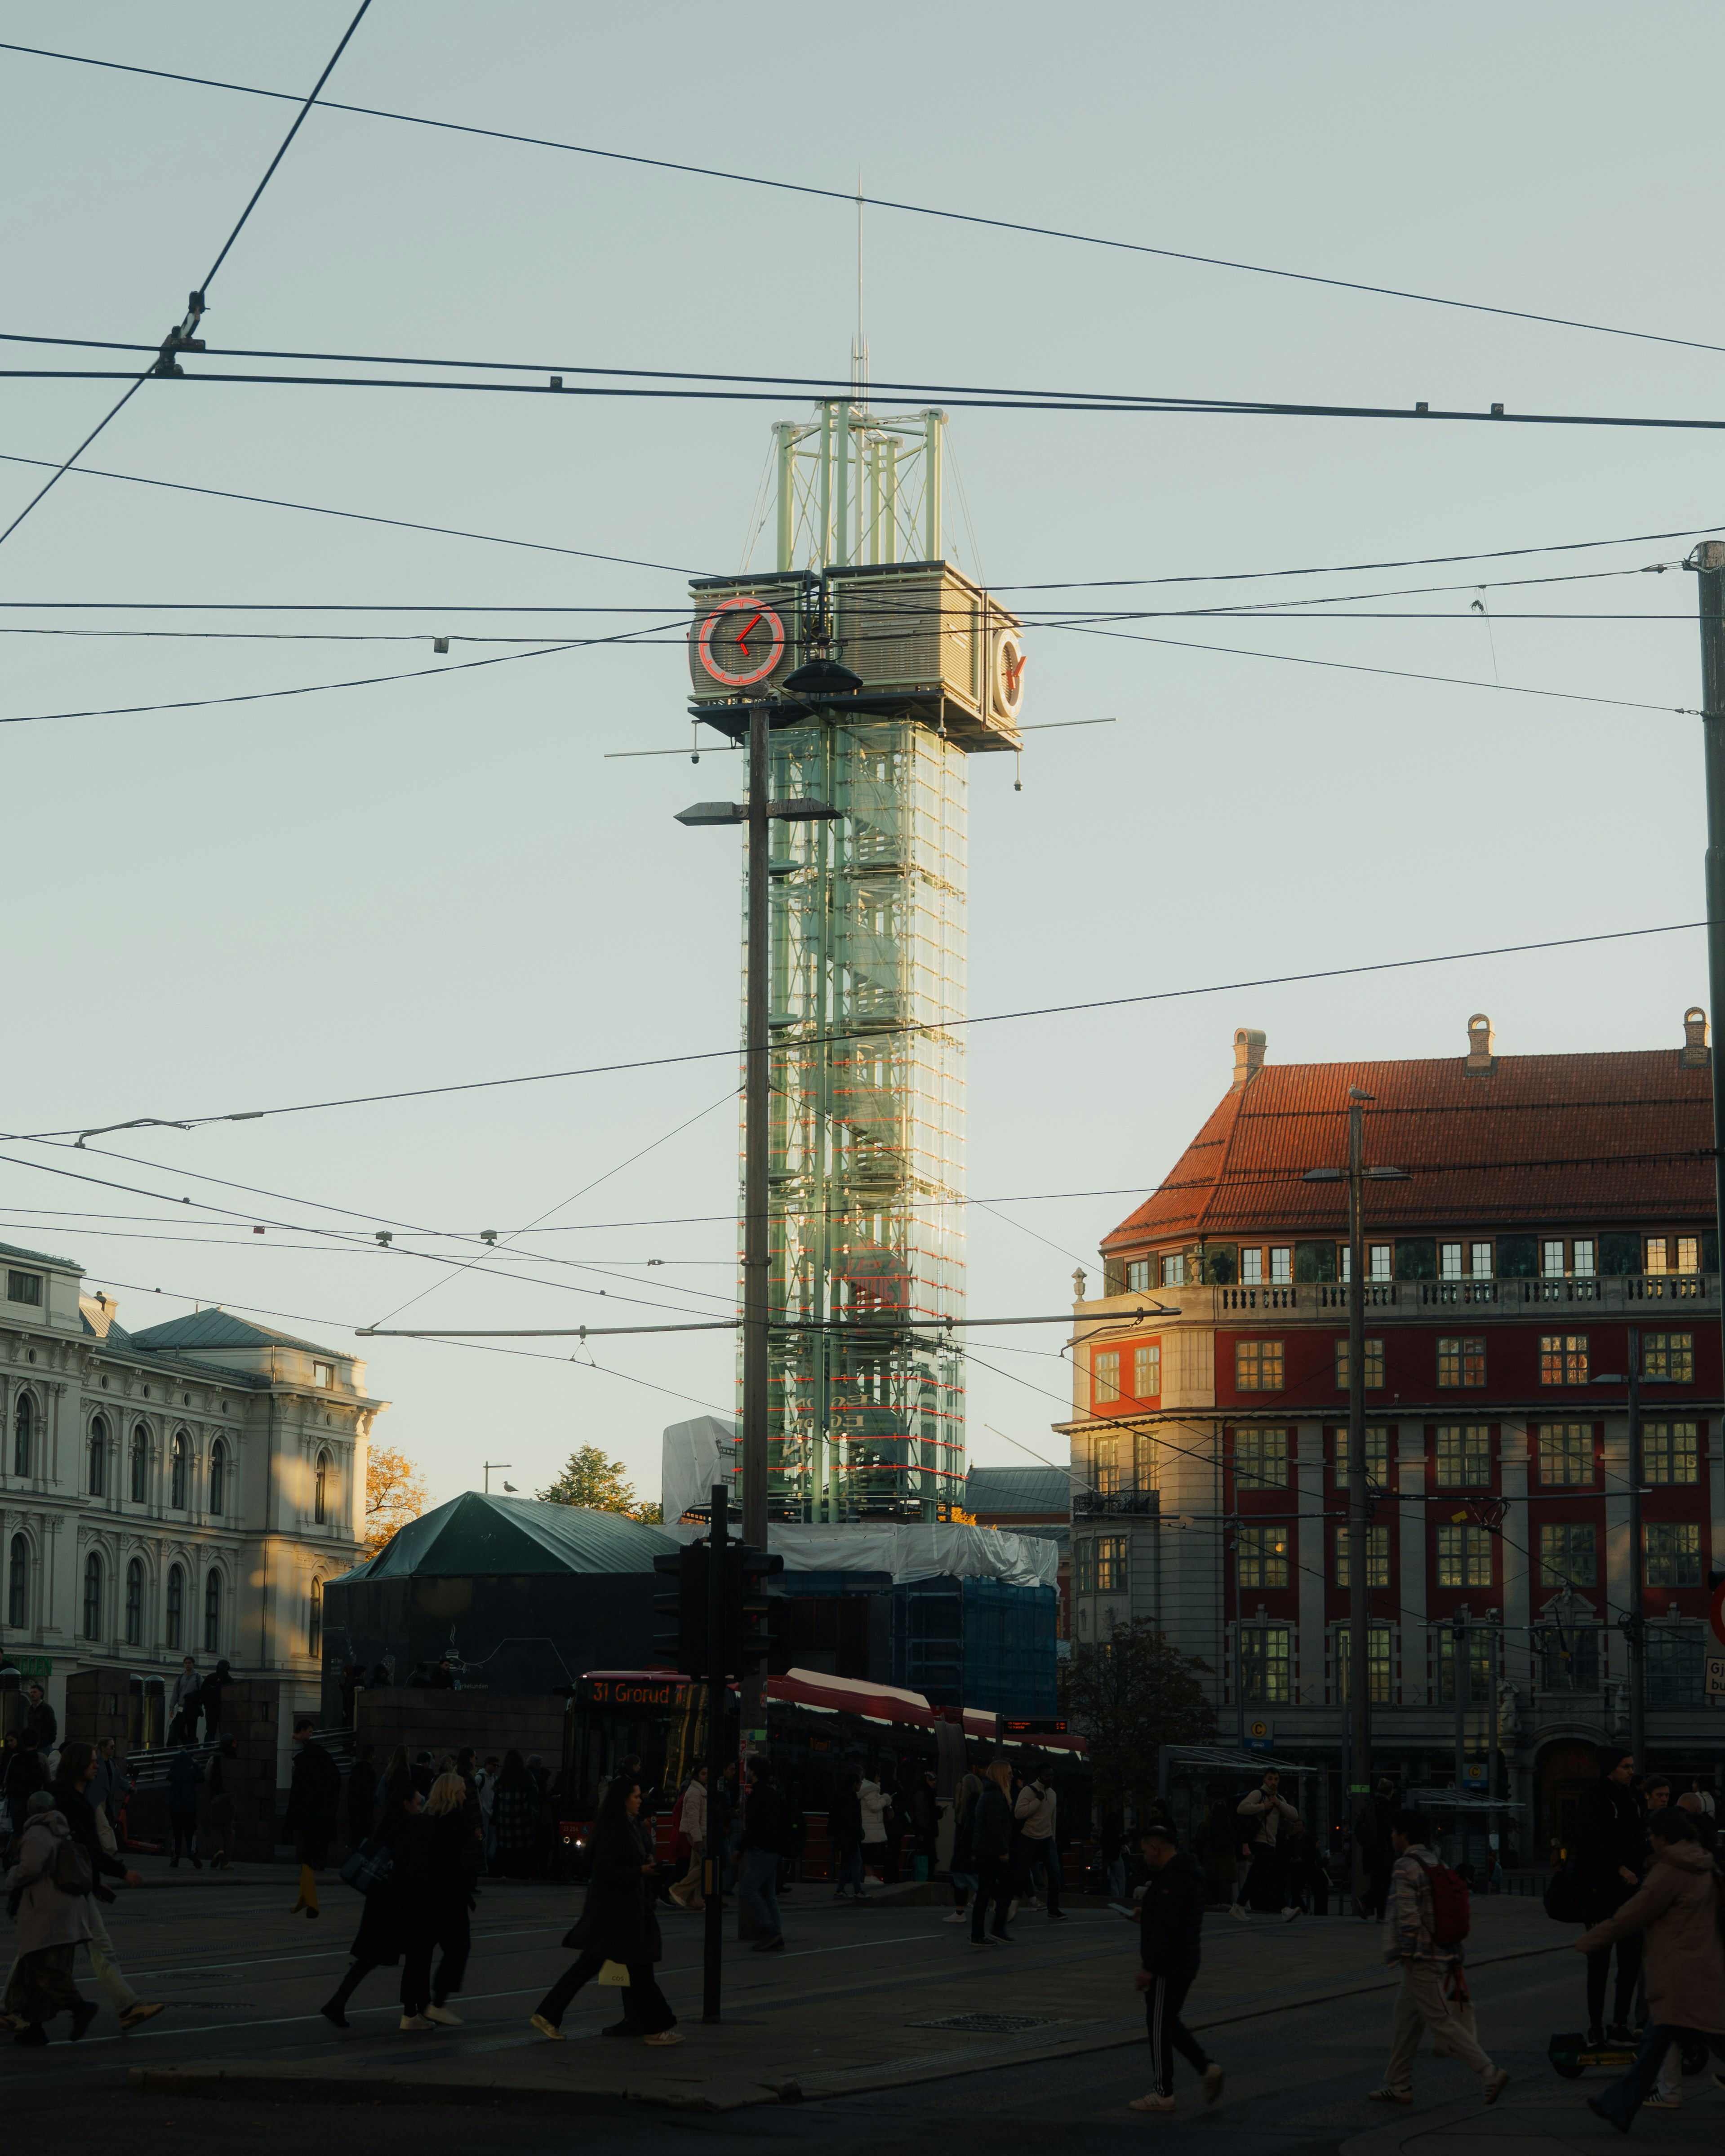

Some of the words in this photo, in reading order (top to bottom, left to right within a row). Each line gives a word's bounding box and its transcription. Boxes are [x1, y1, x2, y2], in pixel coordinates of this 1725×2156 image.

[1711, 1663, 1725, 1677] Gj
[593, 1682, 609, 1701] 31
[615, 1683, 669, 1703] Grorud
[676, 1685, 686, 1703] T
[1255, 1724, 1262, 1734] C
[1472, 1767, 1478, 1776] C
